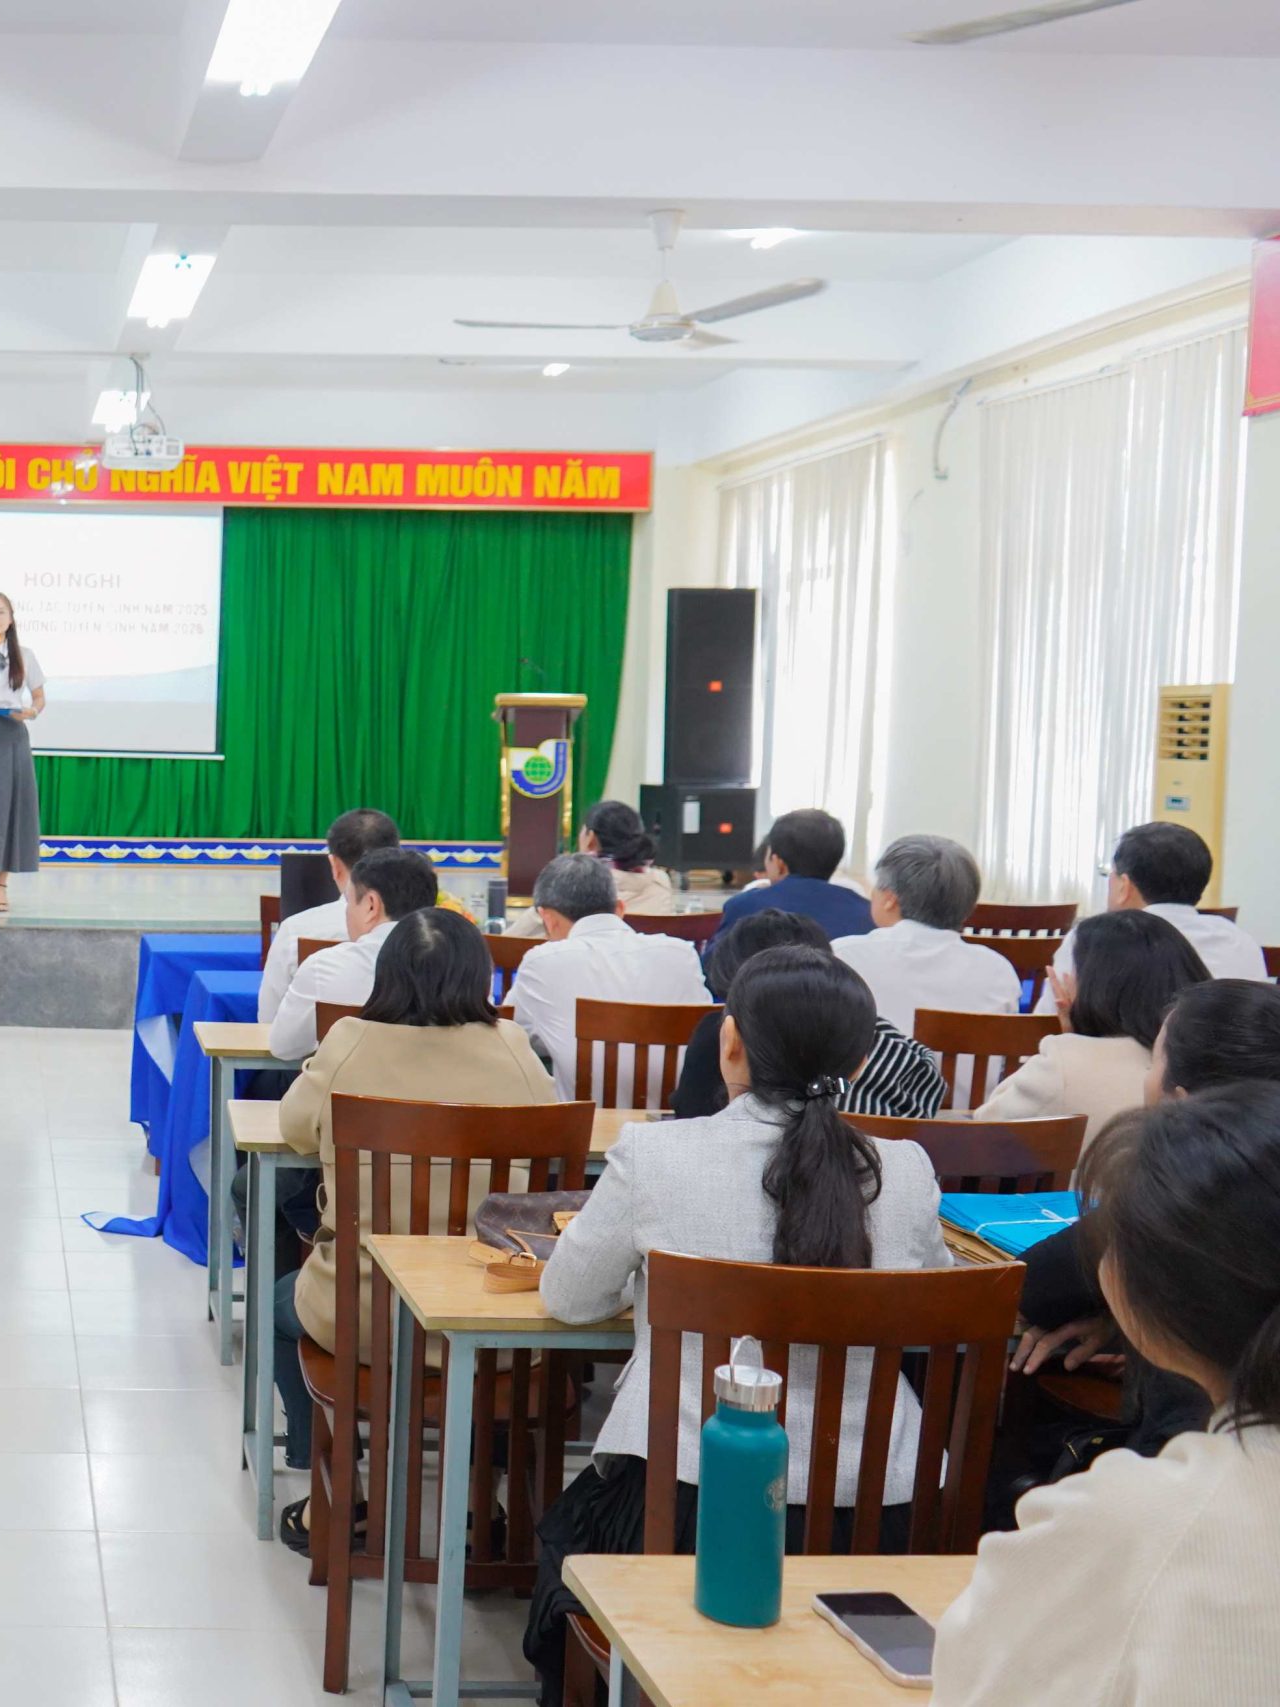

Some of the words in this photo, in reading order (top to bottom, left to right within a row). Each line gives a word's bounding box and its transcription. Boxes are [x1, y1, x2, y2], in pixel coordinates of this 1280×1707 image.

[28, 448, 99, 492] CHỦ
[109, 454, 221, 493] NGHĨA
[228, 455, 304, 501] VIỆT
[318, 462, 404, 496] NAM
[416, 457, 523, 498] MUÔN
[534, 459, 620, 499] NĂM
